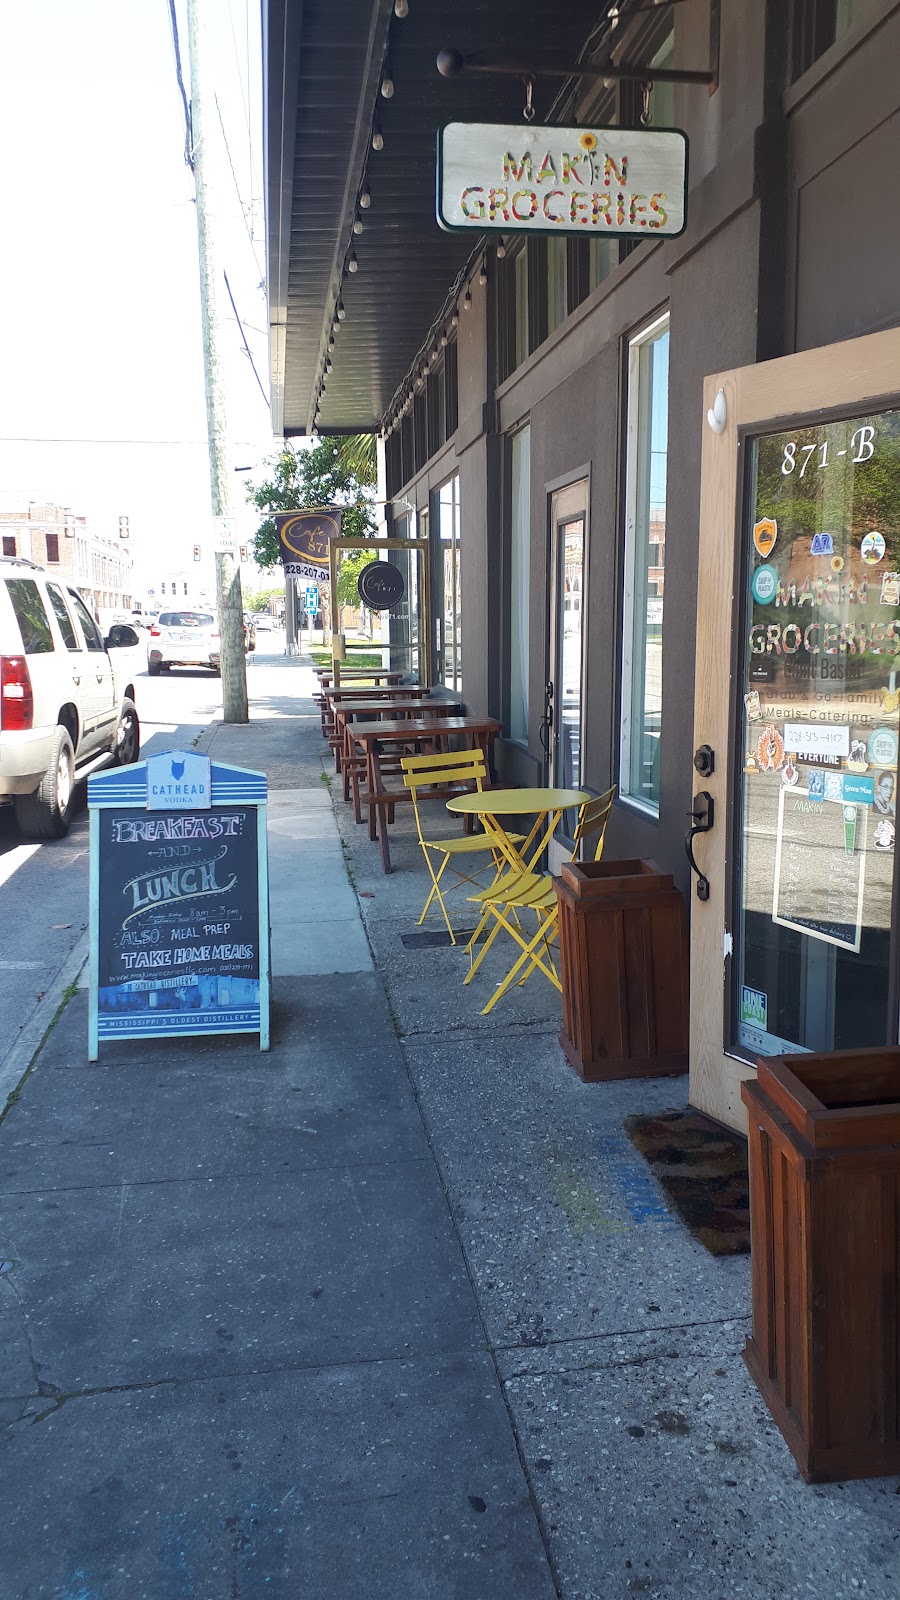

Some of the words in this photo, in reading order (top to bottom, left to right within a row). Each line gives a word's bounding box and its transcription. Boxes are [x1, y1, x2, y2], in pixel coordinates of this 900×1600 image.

[502, 150, 628, 186] MAKIN
[460, 186, 668, 228] GROCERIES
[781, 426, 875, 479] 871-B
[289, 522, 326, 542] Cafe
[308, 541, 329, 555] 871
[285, 564, 330, 581] 228-207-01
[307, 594, 316, 606] H
[749, 619, 900, 656] GROCERIES
[152, 784, 205, 795] CATHEAD
[116, 815, 240, 843] BREAKFAST
[157, 845, 191, 857] AND
[132, 862, 221, 910] LUNCH
[189, 907, 209, 917] 8am
[219, 905, 239, 919] 3pm
[120, 928, 160, 946] ALSO
[171, 927, 200, 940] MEAL
[202, 922, 231, 936] PREP
[121, 950, 172, 969] TAKE
[173, 945, 211, 965] HOME
[212, 944, 254, 961] MEALS
[744, 989, 765, 1008] ONE
[109, 1018, 167, 1027] MISSISSIPPI'S
[171, 1016, 201, 1025] OLDEST
[204, 1014, 250, 1023] DISTILLERY
